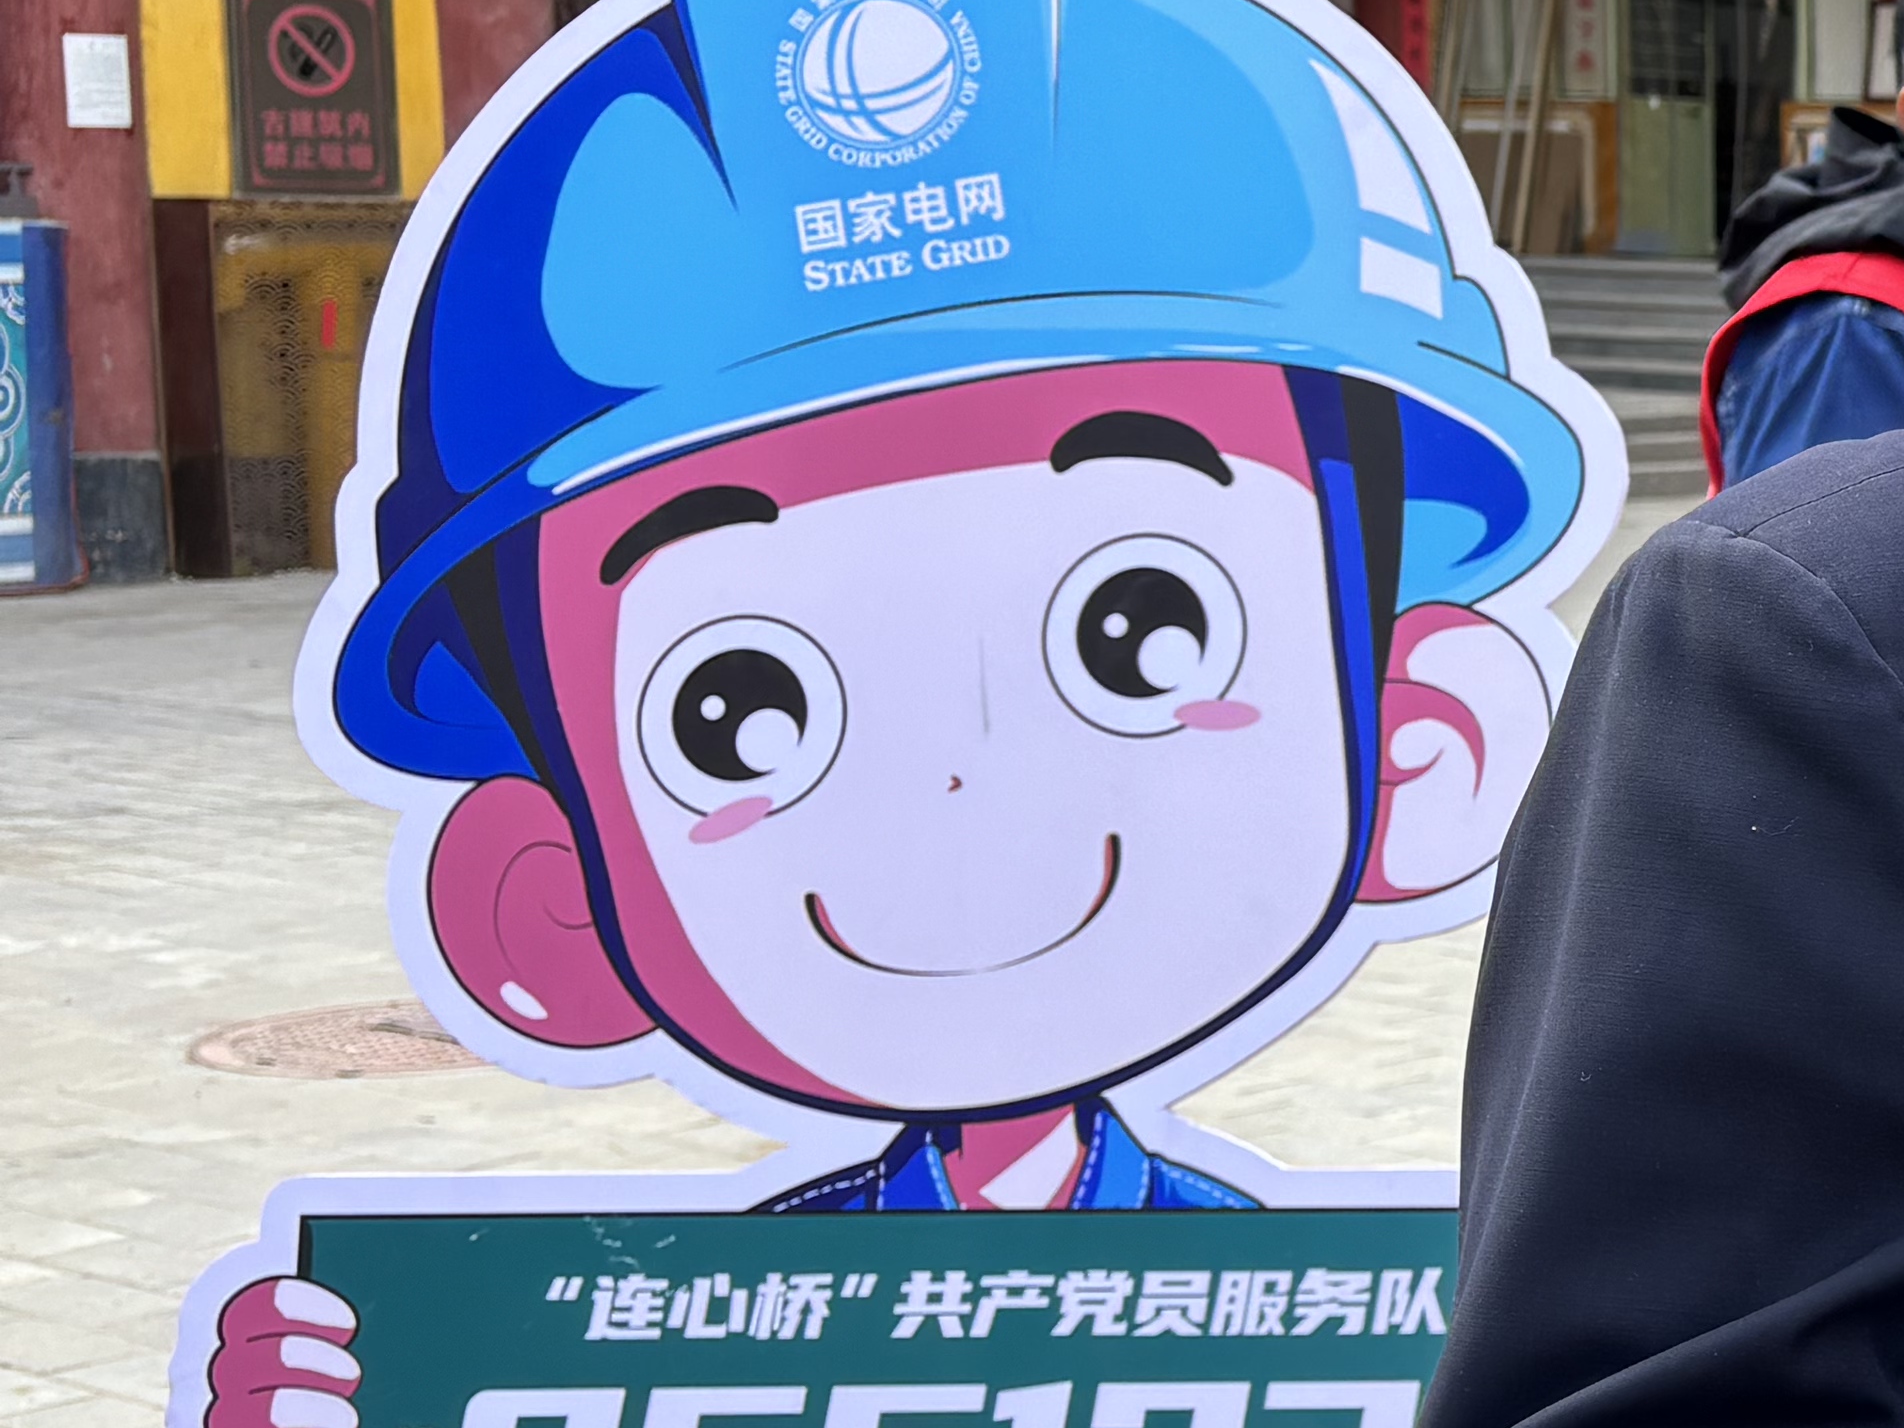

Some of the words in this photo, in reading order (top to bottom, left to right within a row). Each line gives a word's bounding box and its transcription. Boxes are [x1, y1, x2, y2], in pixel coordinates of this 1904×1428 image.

[949, 9, 983, 73] CHINA
[775, 39, 798, 106] STATE
[959, 76, 981, 106] OF
[784, 107, 830, 150] GRID
[827, 110, 970, 169] CORPORATION
[794, 172, 1006, 254] 国家电网
